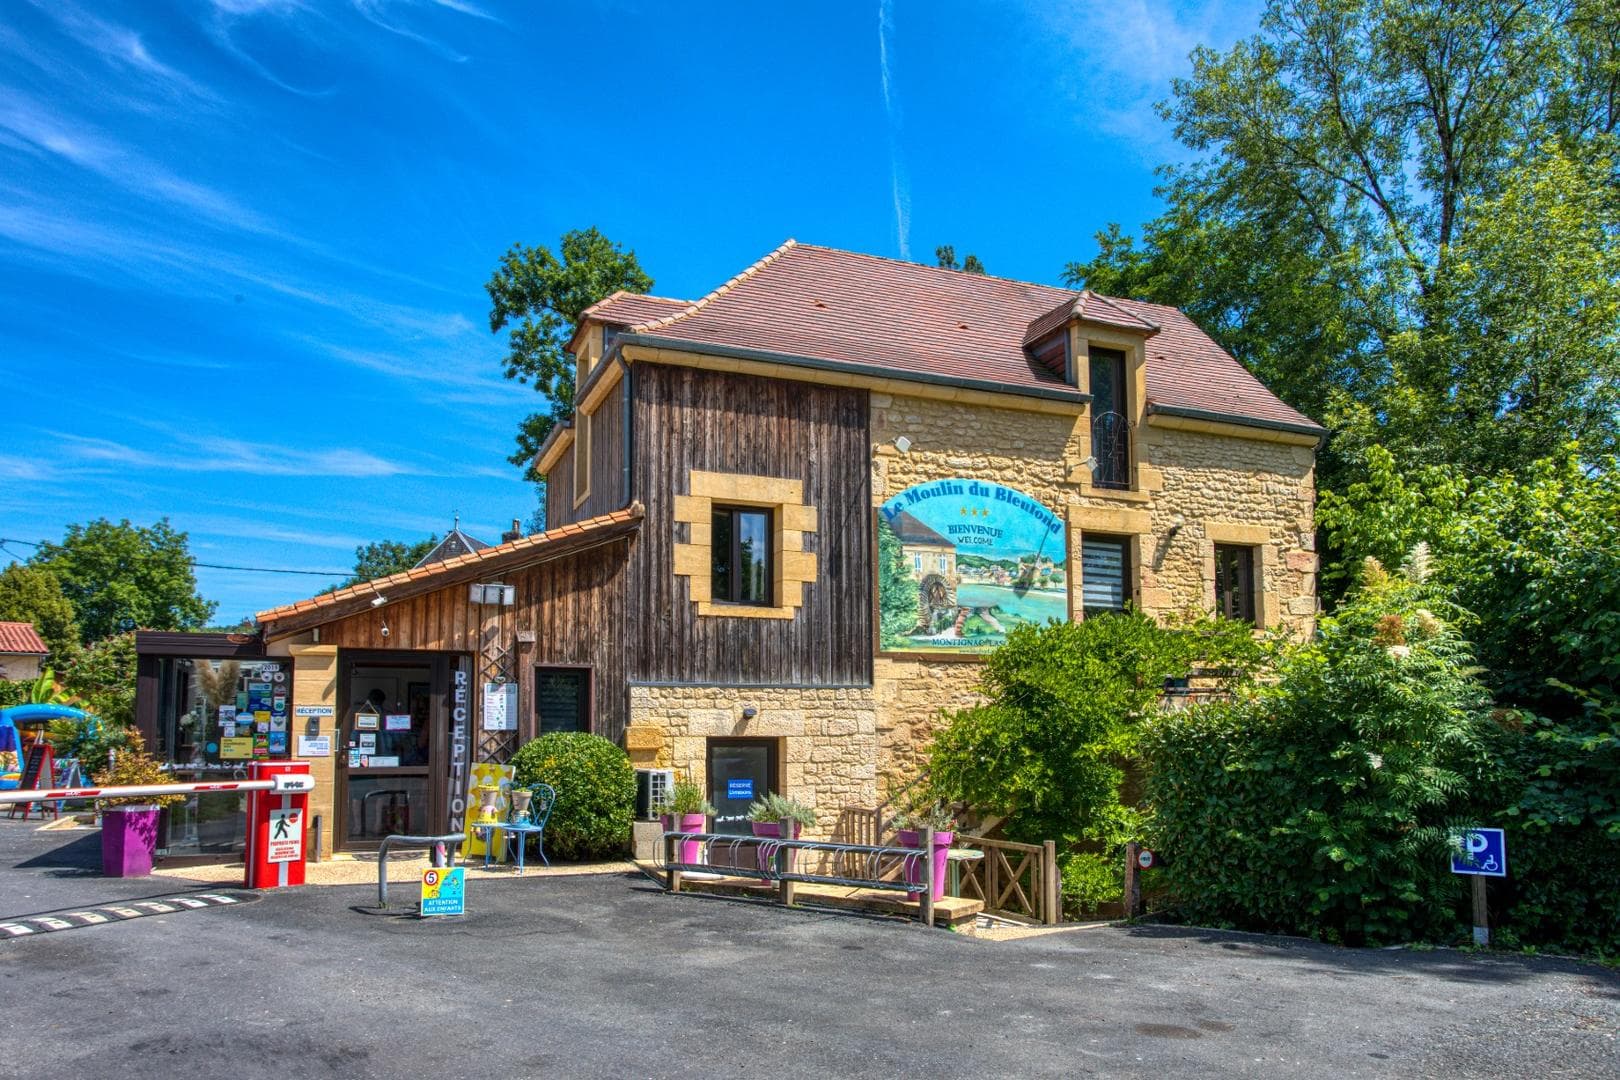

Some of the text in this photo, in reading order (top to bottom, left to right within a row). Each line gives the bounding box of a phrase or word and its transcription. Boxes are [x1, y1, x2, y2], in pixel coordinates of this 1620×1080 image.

[882, 482, 1062, 535] Le Moulin du Bleufond
[947, 524, 1003, 539] BIENVENUE
[957, 536, 993, 546] WELCOME
[1466, 833, 1488, 861] P
[428, 872, 435, 883] 5
